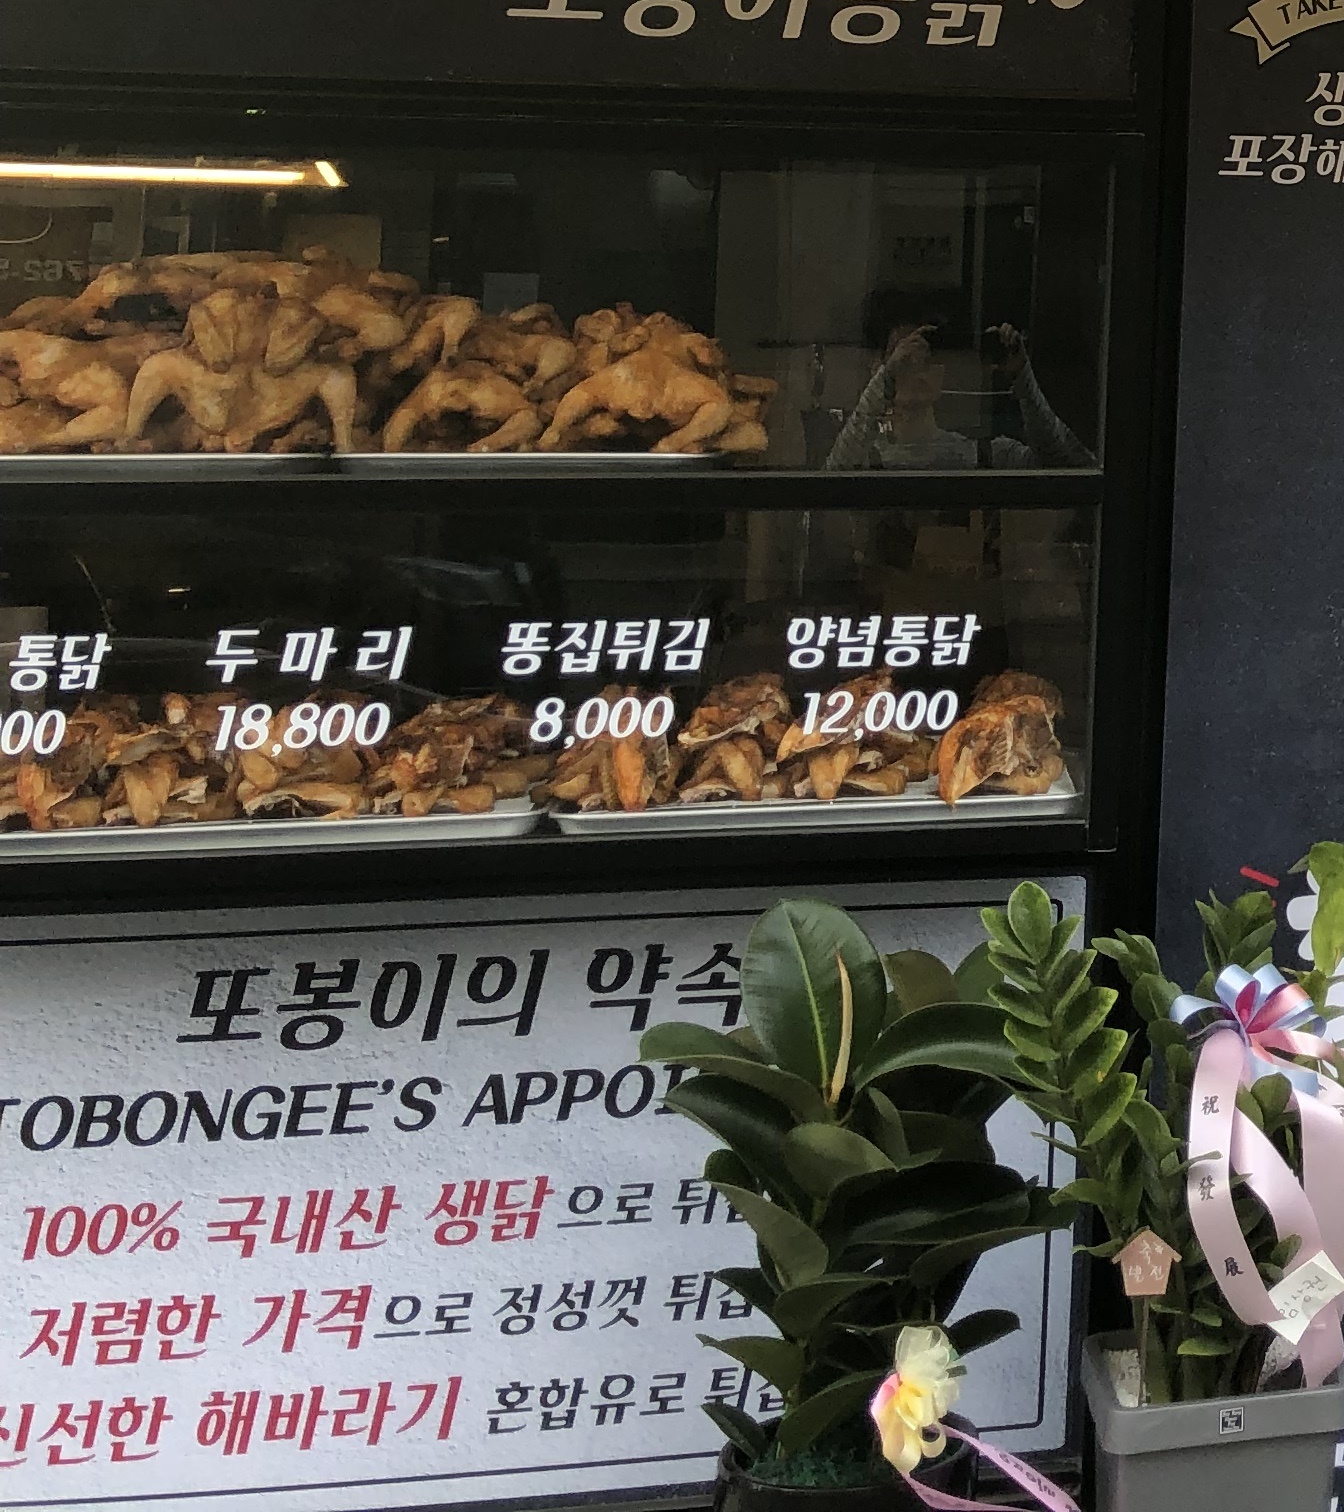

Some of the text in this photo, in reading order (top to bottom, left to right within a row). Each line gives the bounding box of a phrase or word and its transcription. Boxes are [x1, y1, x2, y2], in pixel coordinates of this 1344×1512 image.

[8, 633, 112, 692] 통닭
[500, 617, 712, 677] 똥집튀김
[786, 613, 982, 670] 양념통닭
[213, 701, 391, 758] 18,800
[528, 695, 676, 750] 8,000
[801, 688, 959, 742] 12,000
[176, 946, 551, 1051] 또봉이의
[22, 1199, 184, 1262] 100%
[205, 1183, 403, 1258] 국내산
[19, 1294, 222, 1367] 저렴한
[241, 1282, 474, 1354] 가격으로
[492, 1274, 648, 1338] 정성껏
[197, 1374, 465, 1458] 해바라기
[485, 1371, 687, 1439] 혼합유로
